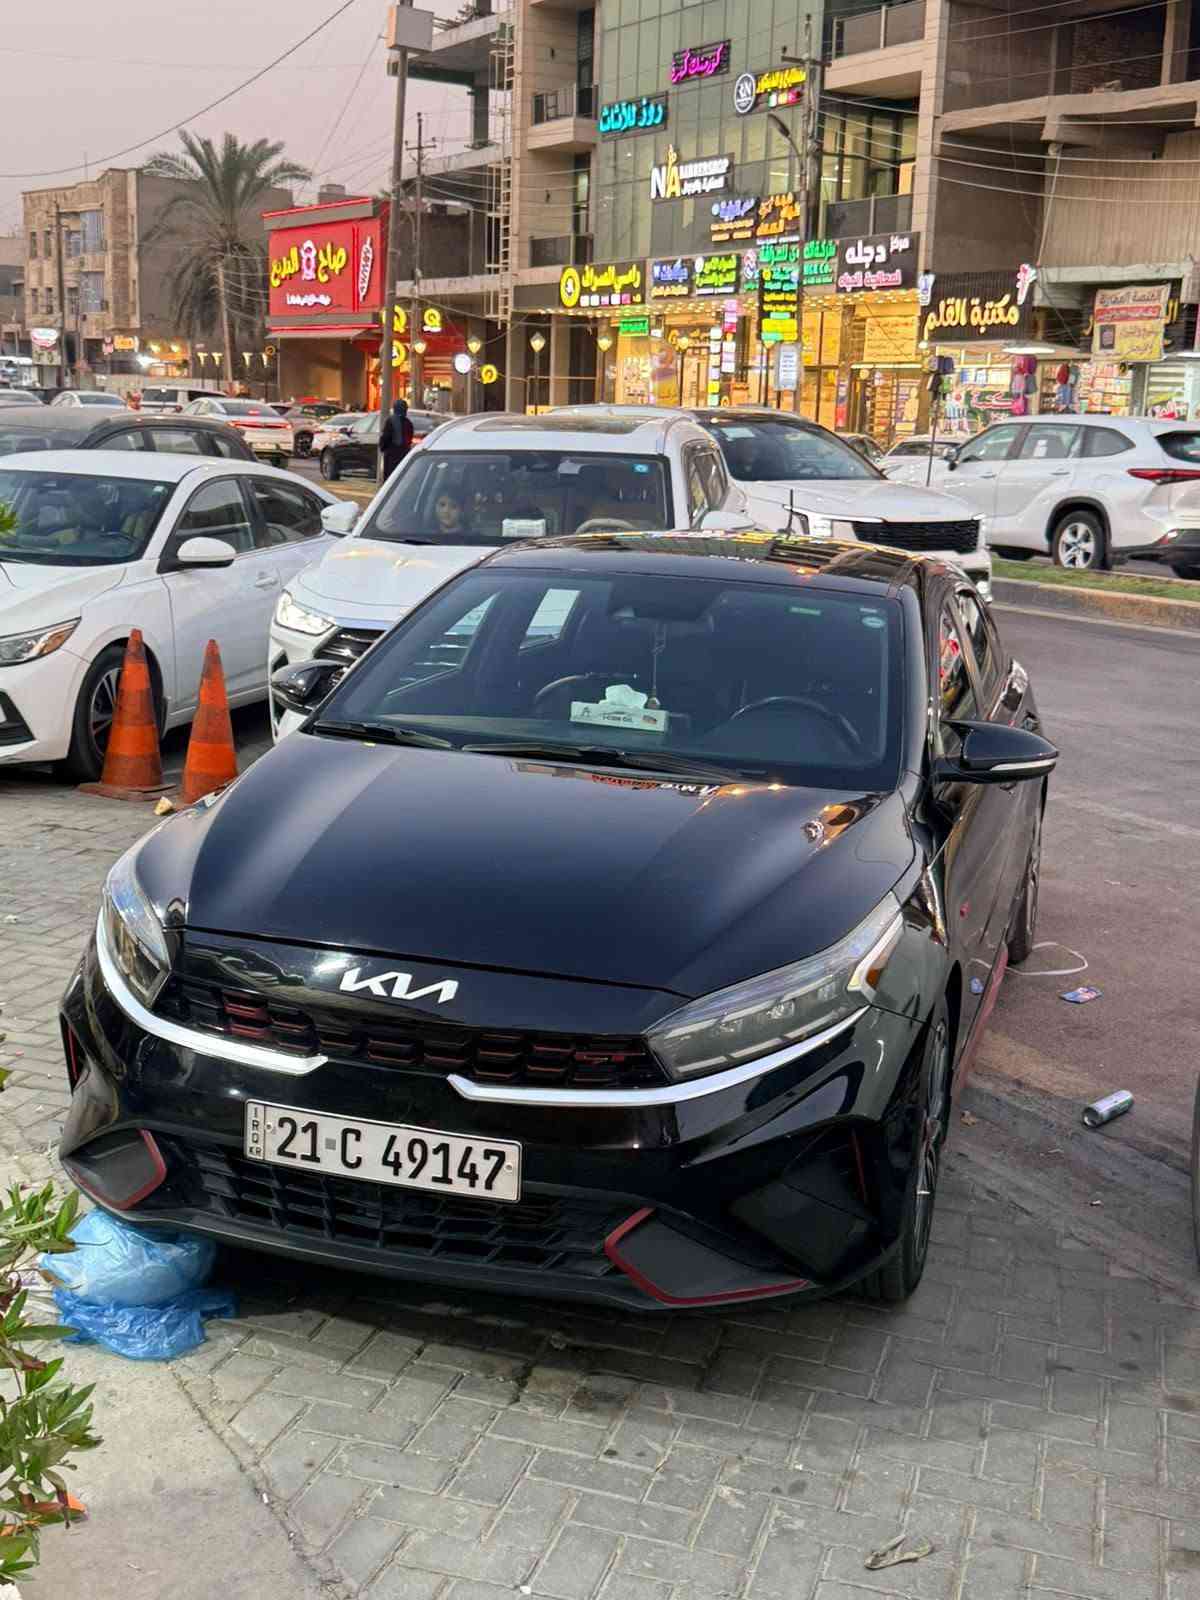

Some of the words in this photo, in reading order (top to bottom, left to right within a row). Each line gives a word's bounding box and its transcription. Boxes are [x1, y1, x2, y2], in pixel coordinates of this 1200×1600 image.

[637, 97, 664, 127] روز
[845, 239, 887, 269] دجله
[889, 235, 910, 253] مركز
[923, 296, 968, 341] القلم
[970, 293, 1020, 334] مكتبة
[339, 967, 460, 1004] KIA
[277, 1116, 321, 1164] 21
[340, 1127, 362, 1169] C
[381, 1134, 506, 1191] 49147
